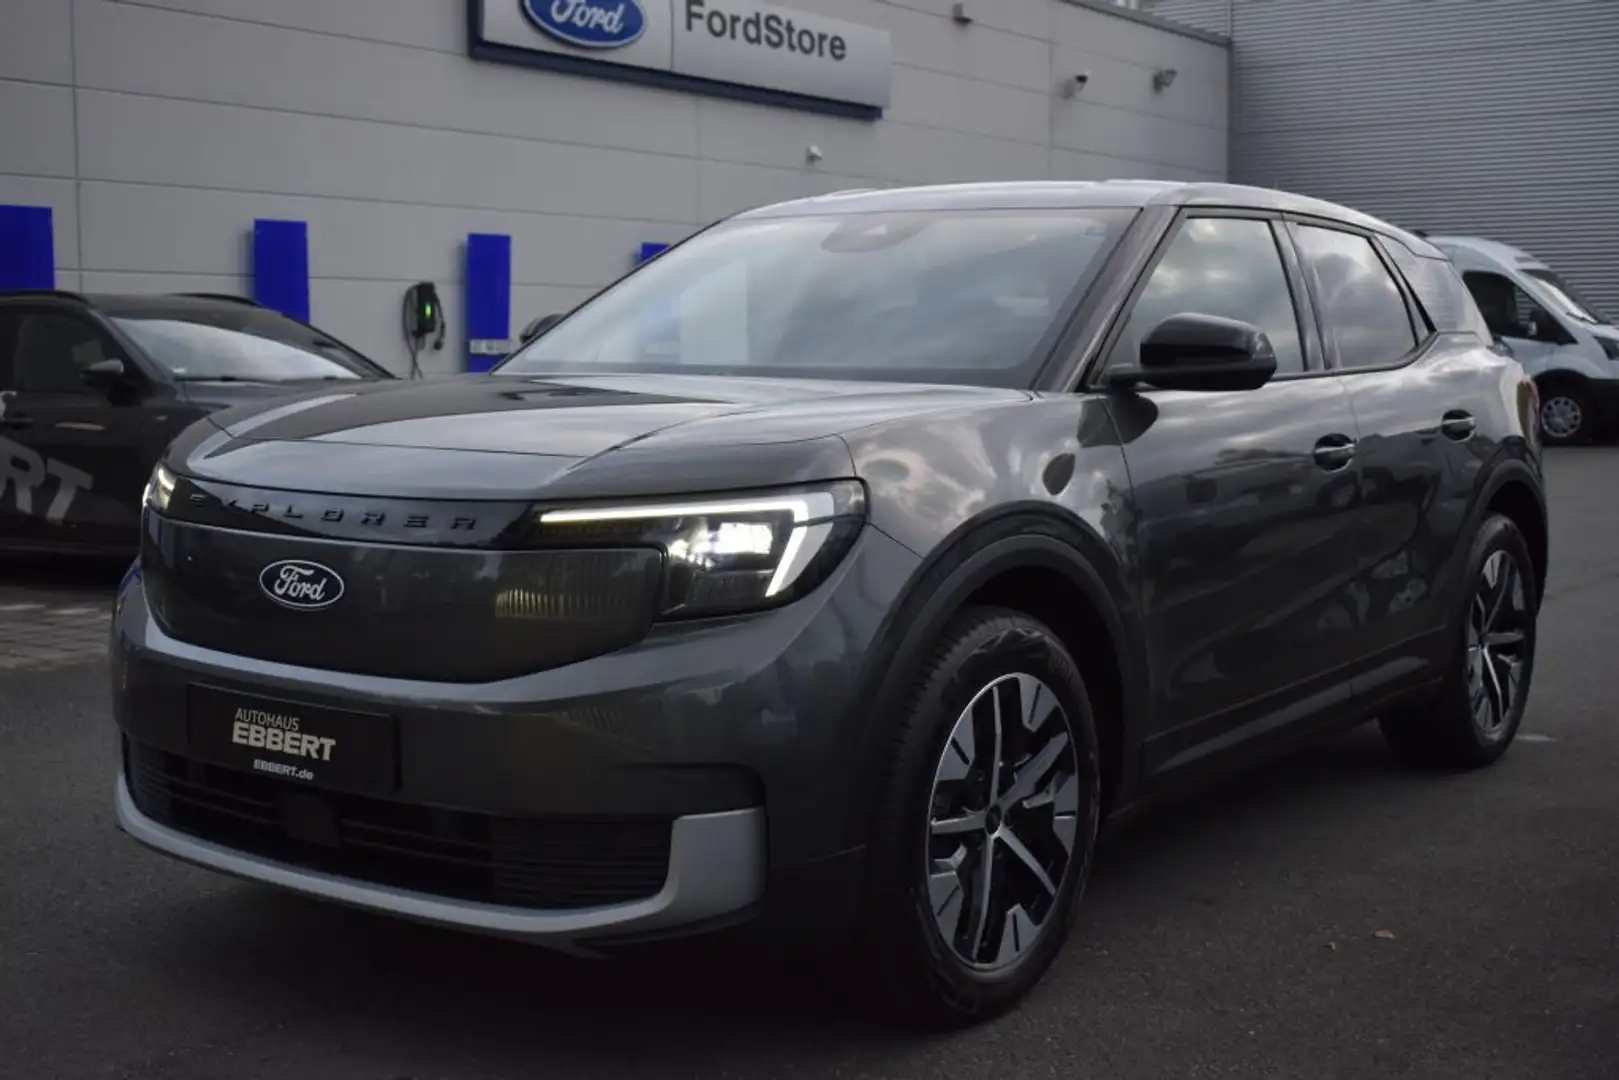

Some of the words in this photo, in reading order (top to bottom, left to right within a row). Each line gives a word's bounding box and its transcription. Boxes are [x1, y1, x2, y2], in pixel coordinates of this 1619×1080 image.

[684, 1, 848, 61] FordStore
[273, 565, 328, 601] Ford
[235, 707, 300, 732] AUTOHAUS
[232, 720, 337, 761] EBBERT
[252, 758, 315, 781] EBBERT.de
